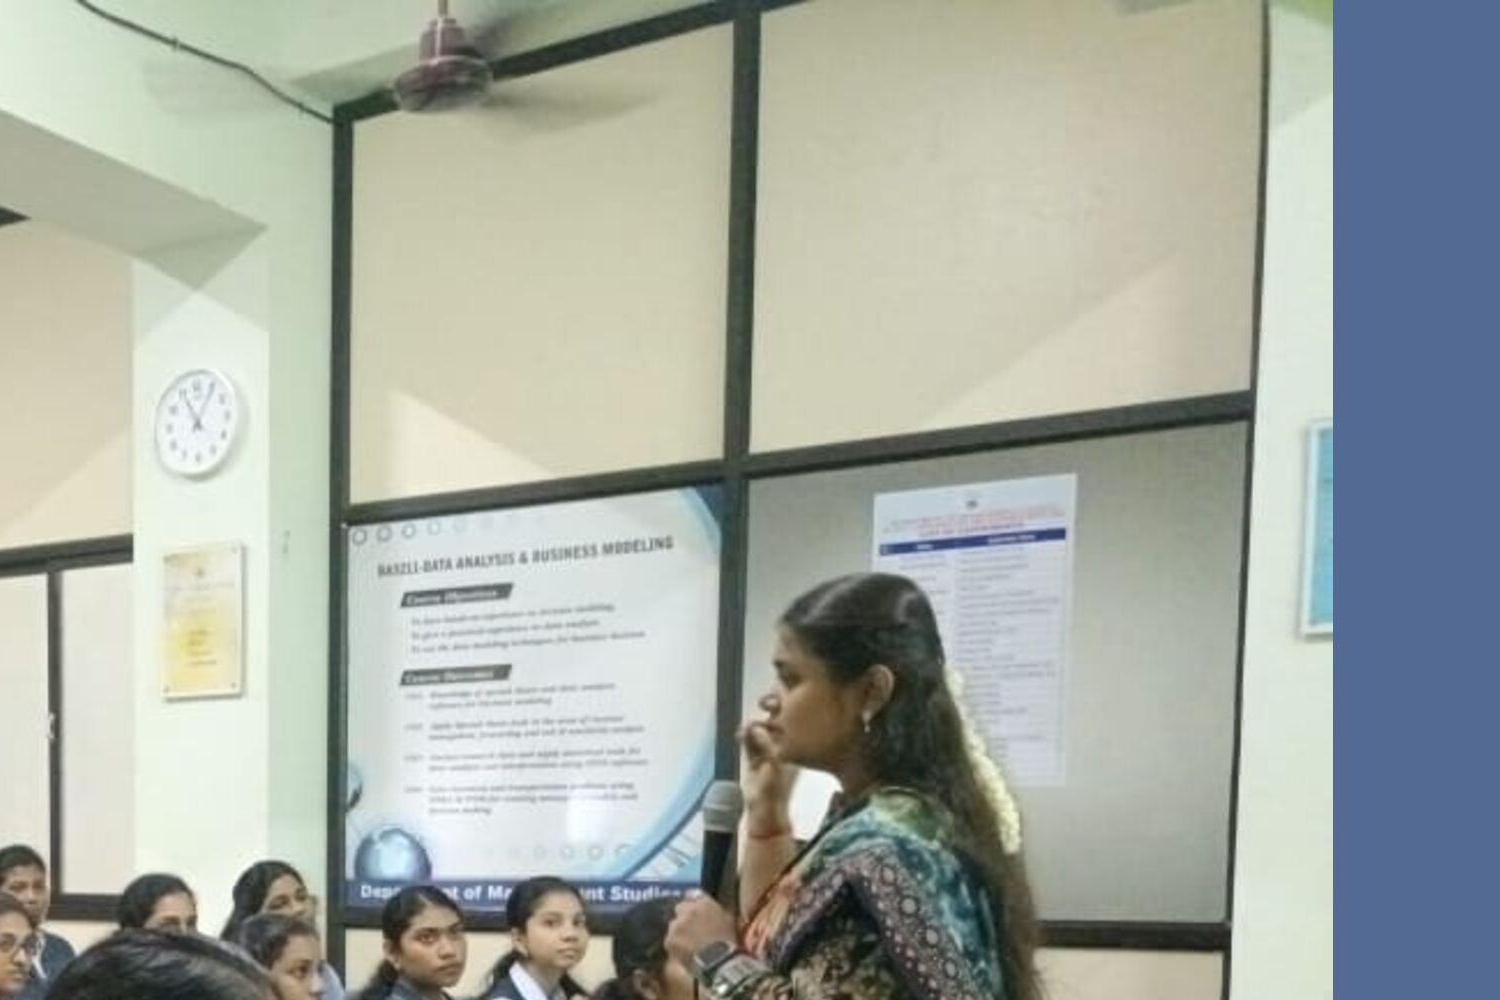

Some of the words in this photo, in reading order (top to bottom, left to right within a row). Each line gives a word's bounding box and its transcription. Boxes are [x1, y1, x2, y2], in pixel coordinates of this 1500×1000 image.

[456, 552, 515, 570] ANALYSIS
[519, 550, 528, 564] &
[532, 543, 598, 562] BUSINESS
[602, 535, 674, 554] MODELING
[463, 886, 482, 900] of
